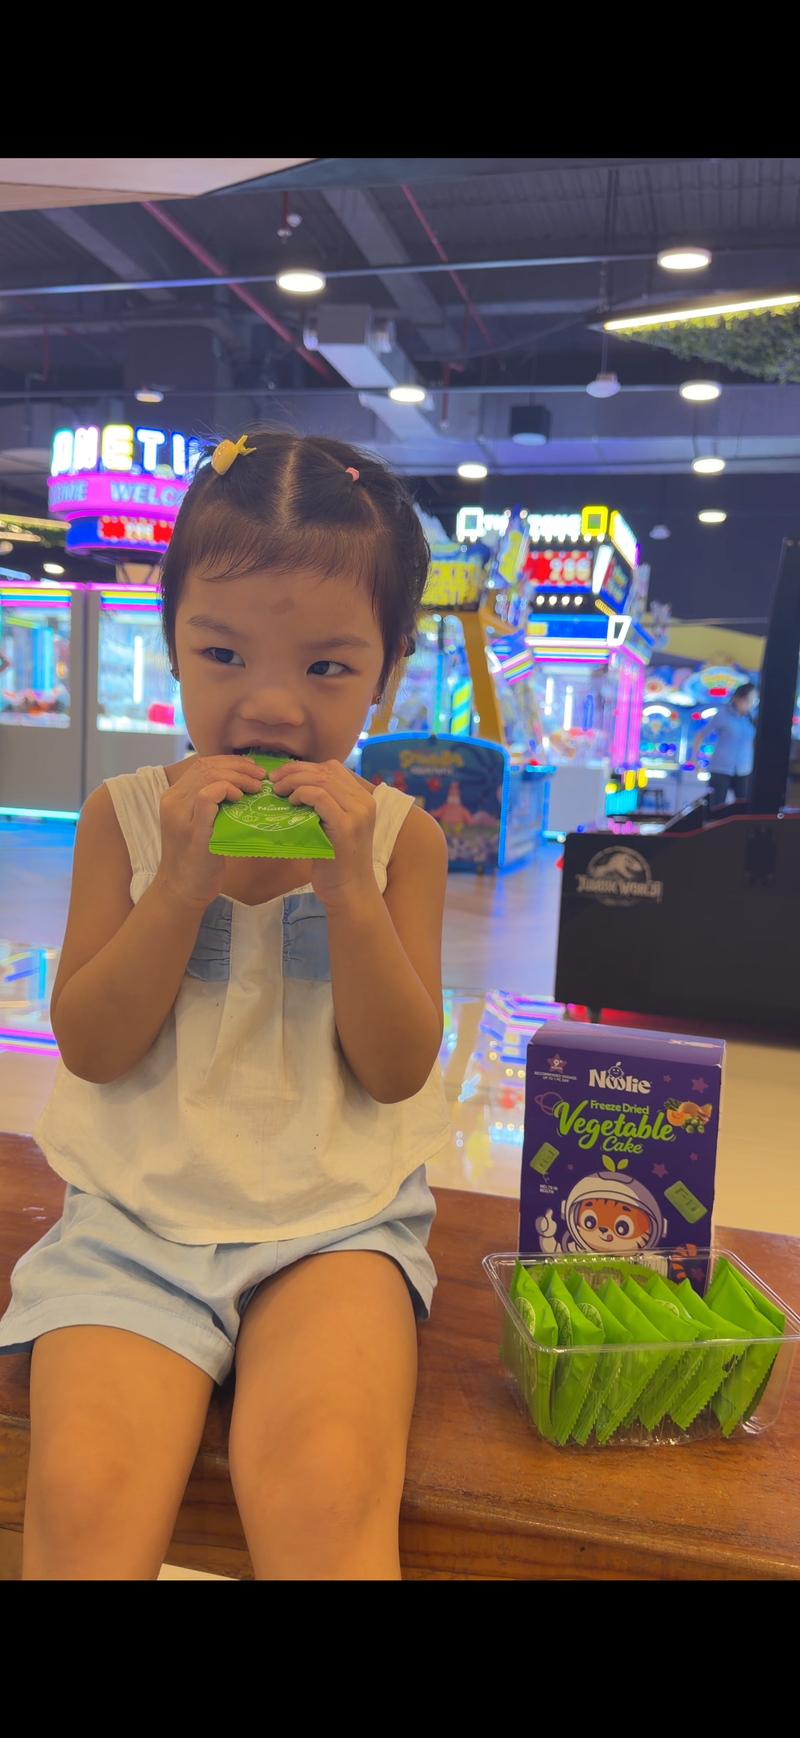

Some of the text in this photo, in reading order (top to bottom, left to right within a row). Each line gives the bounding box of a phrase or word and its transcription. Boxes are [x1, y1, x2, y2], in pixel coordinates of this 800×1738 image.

[575, 874, 663, 904] JURASSIC WORLD
[588, 1068, 652, 1094] Noolie
[590, 1100, 650, 1115] Freeze Dried
[553, 1100, 675, 1150] Vegetable
[602, 1135, 643, 1154] Cake
